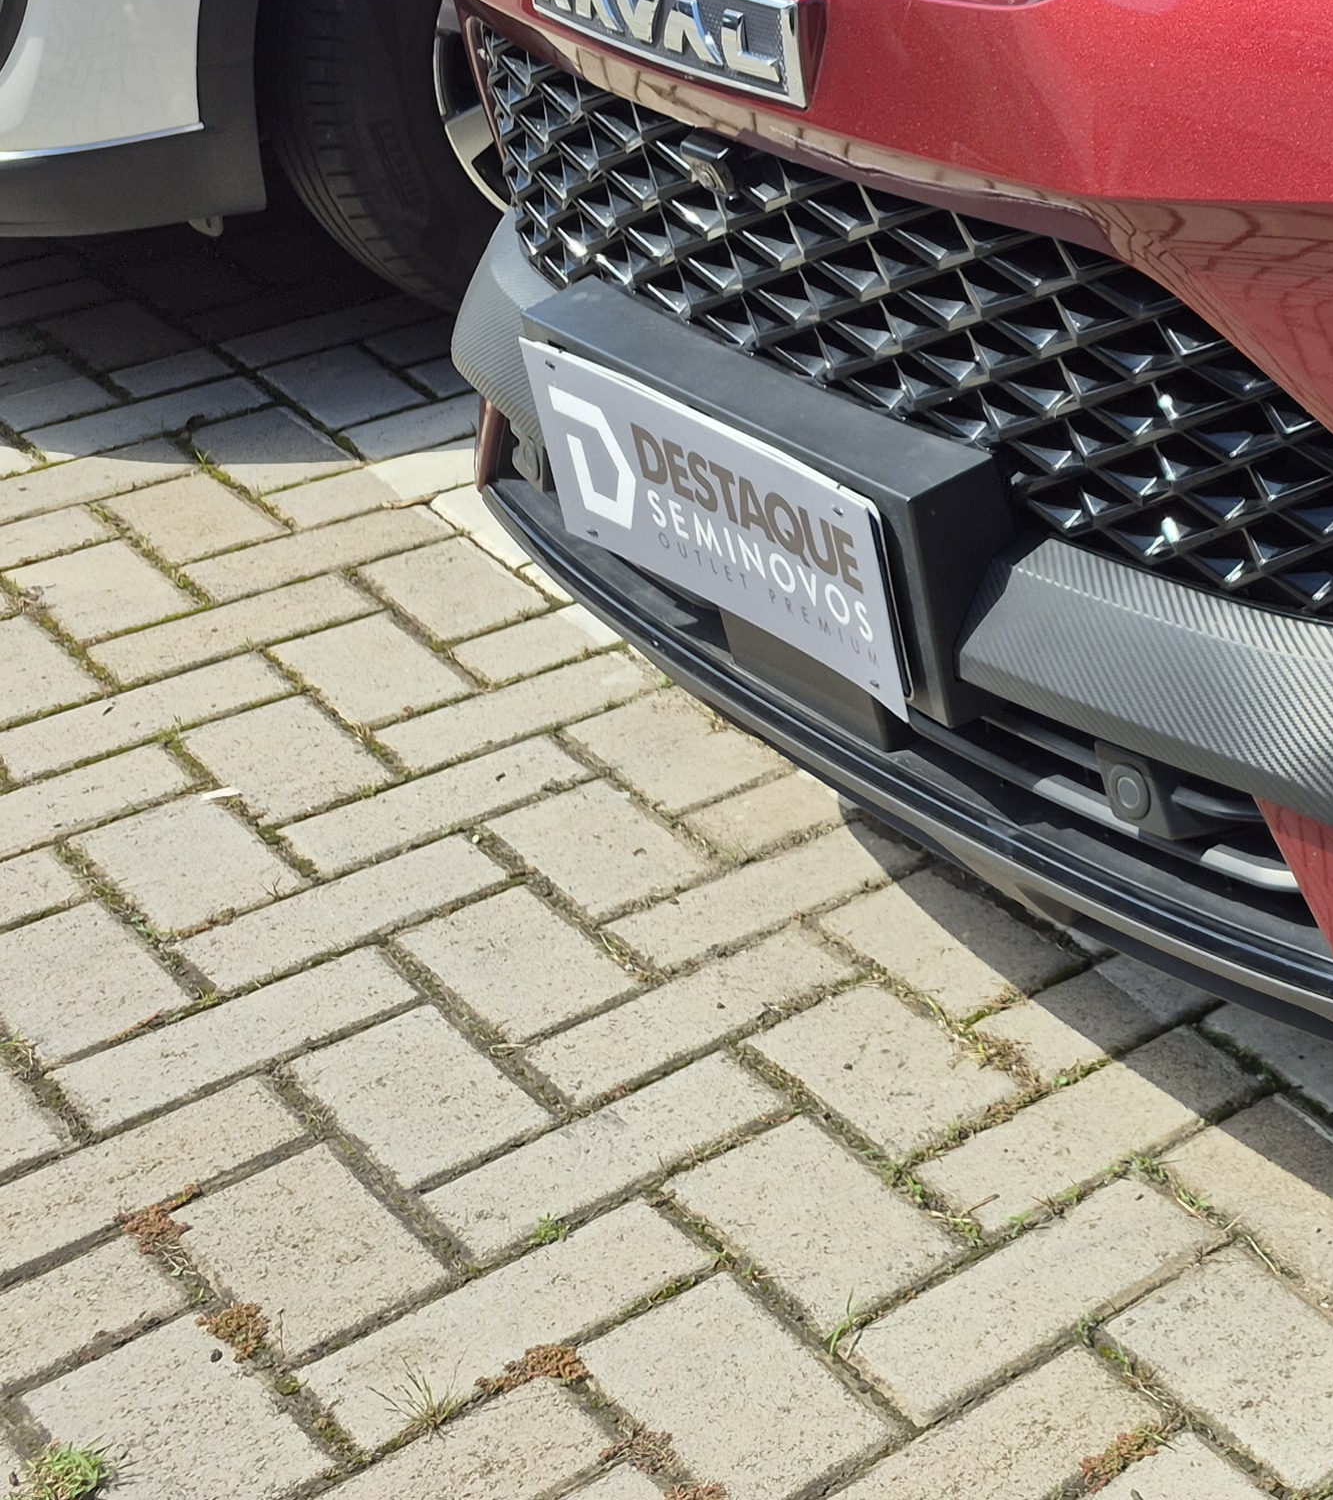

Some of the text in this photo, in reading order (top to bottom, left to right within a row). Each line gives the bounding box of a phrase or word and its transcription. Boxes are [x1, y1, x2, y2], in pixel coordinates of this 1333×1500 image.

[630, 422, 864, 594] DESTAQUE
[646, 489, 874, 642] SEMINOVOS
[658, 532, 881, 669] OUTLET PREMIUM
